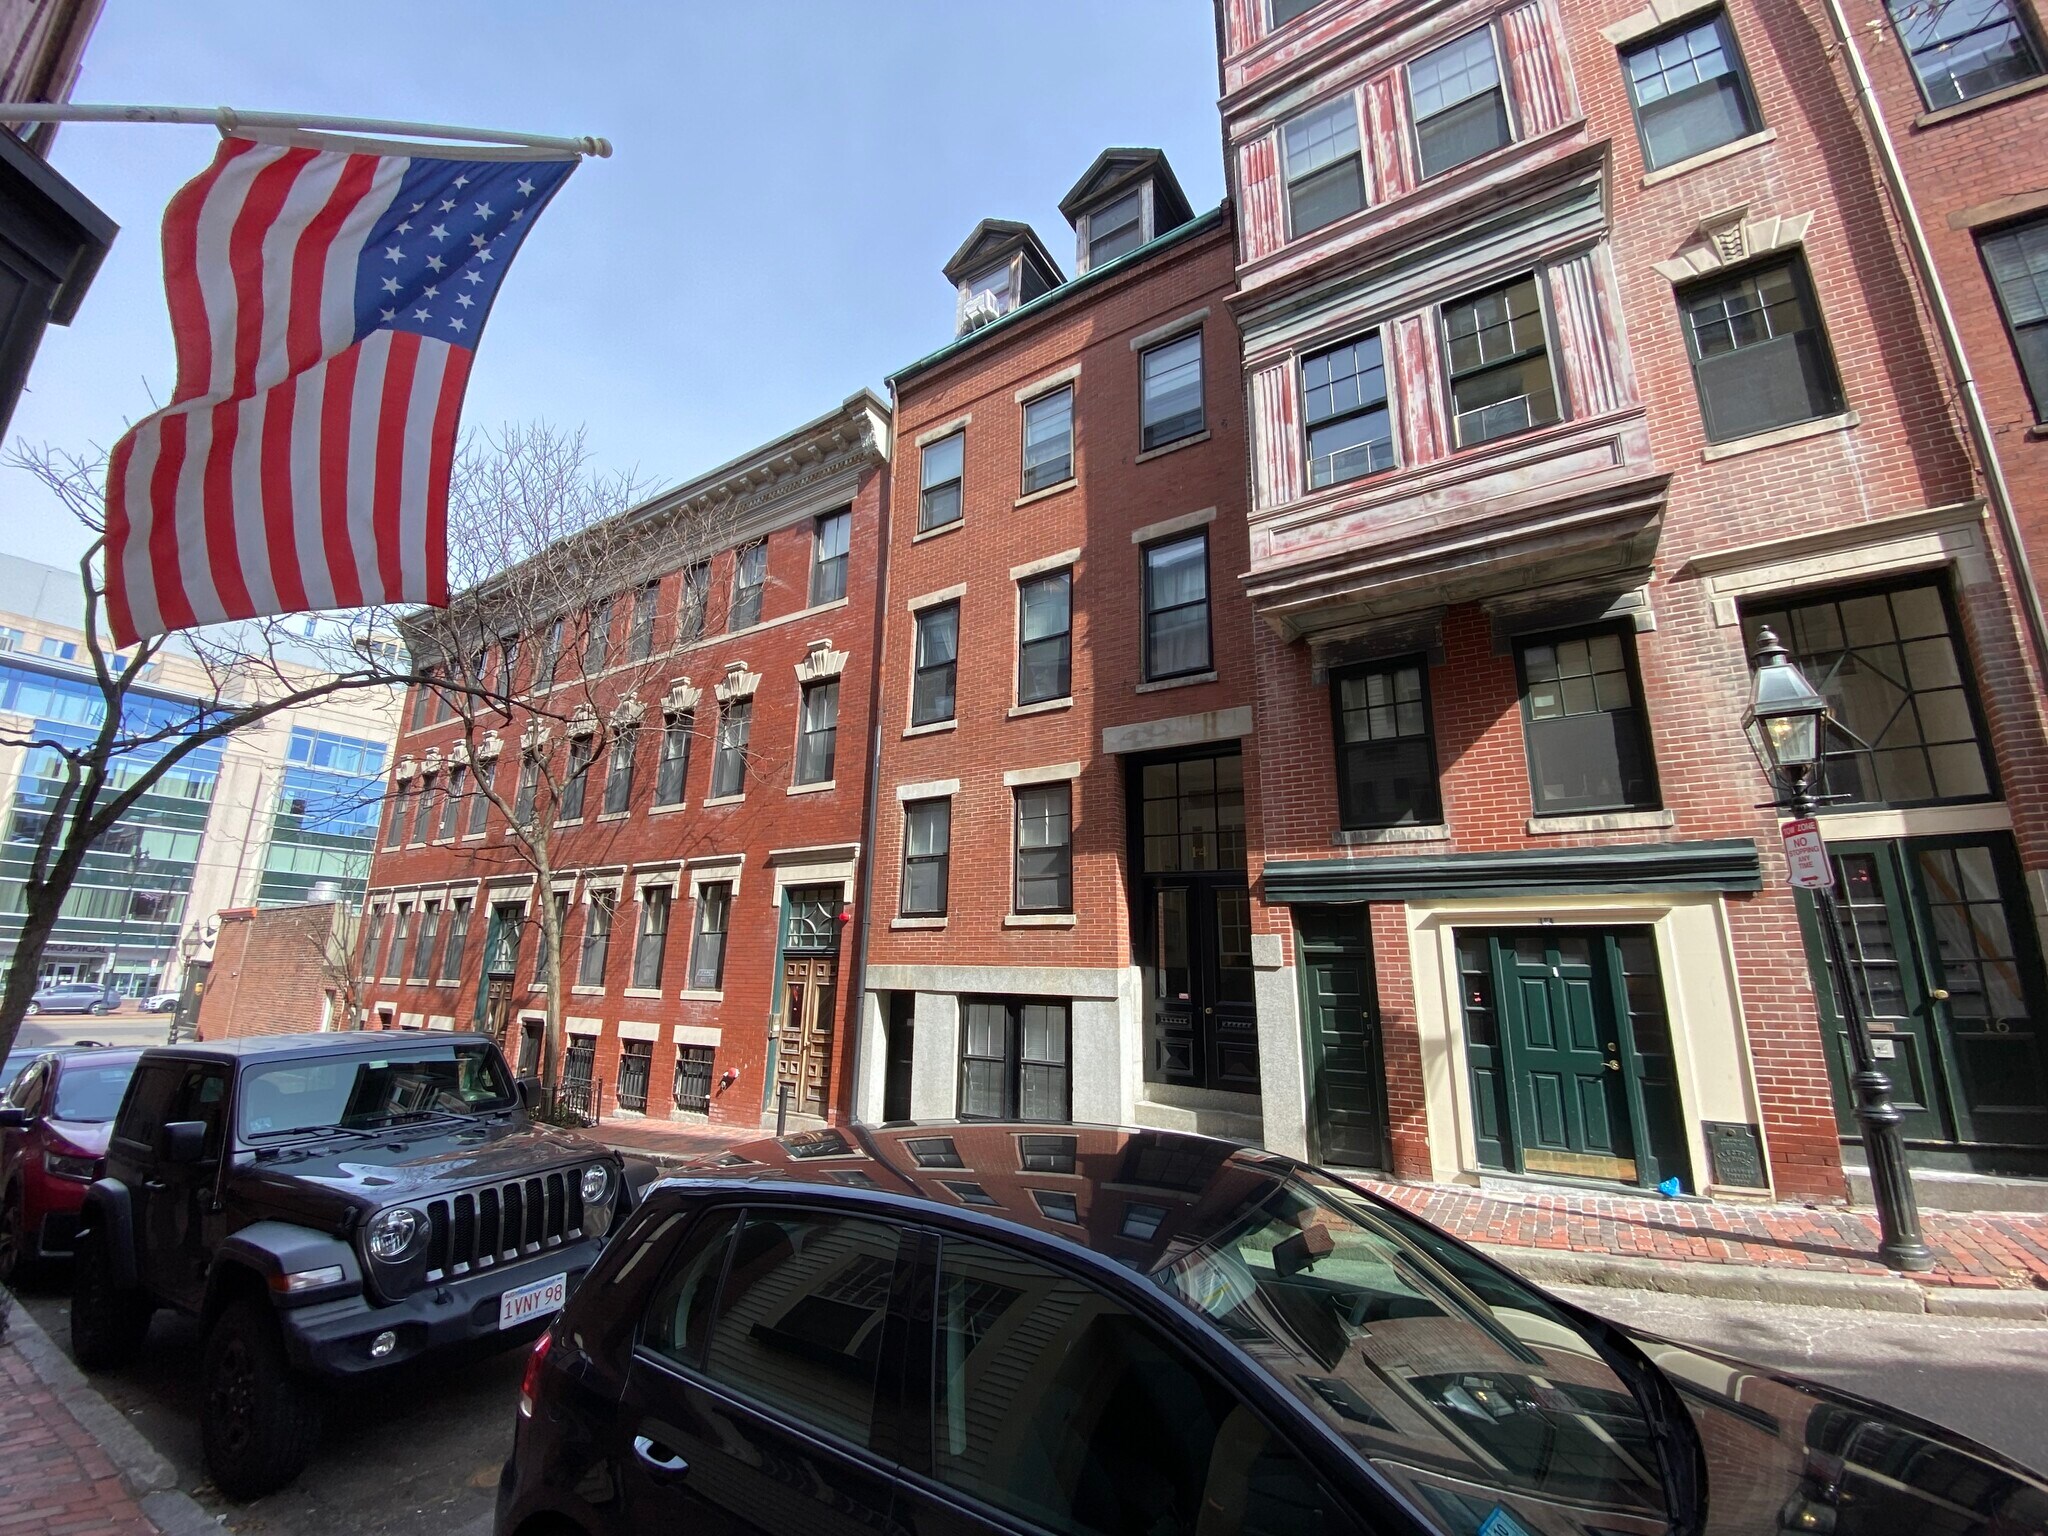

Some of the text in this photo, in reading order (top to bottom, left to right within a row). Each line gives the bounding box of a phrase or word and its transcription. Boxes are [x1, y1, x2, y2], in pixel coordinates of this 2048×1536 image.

[1783, 821, 1816, 836] TOW ZONE
[1793, 837, 1808, 848] NO
[1789, 846, 1820, 857] STOPPING
[1798, 855, 1810, 863] ANY
[1798, 861, 1814, 869] TIME
[1981, 1016, 2009, 1034] 16
[504, 1290, 542, 1320] 1VNY
[545, 1284, 563, 1305] 98
